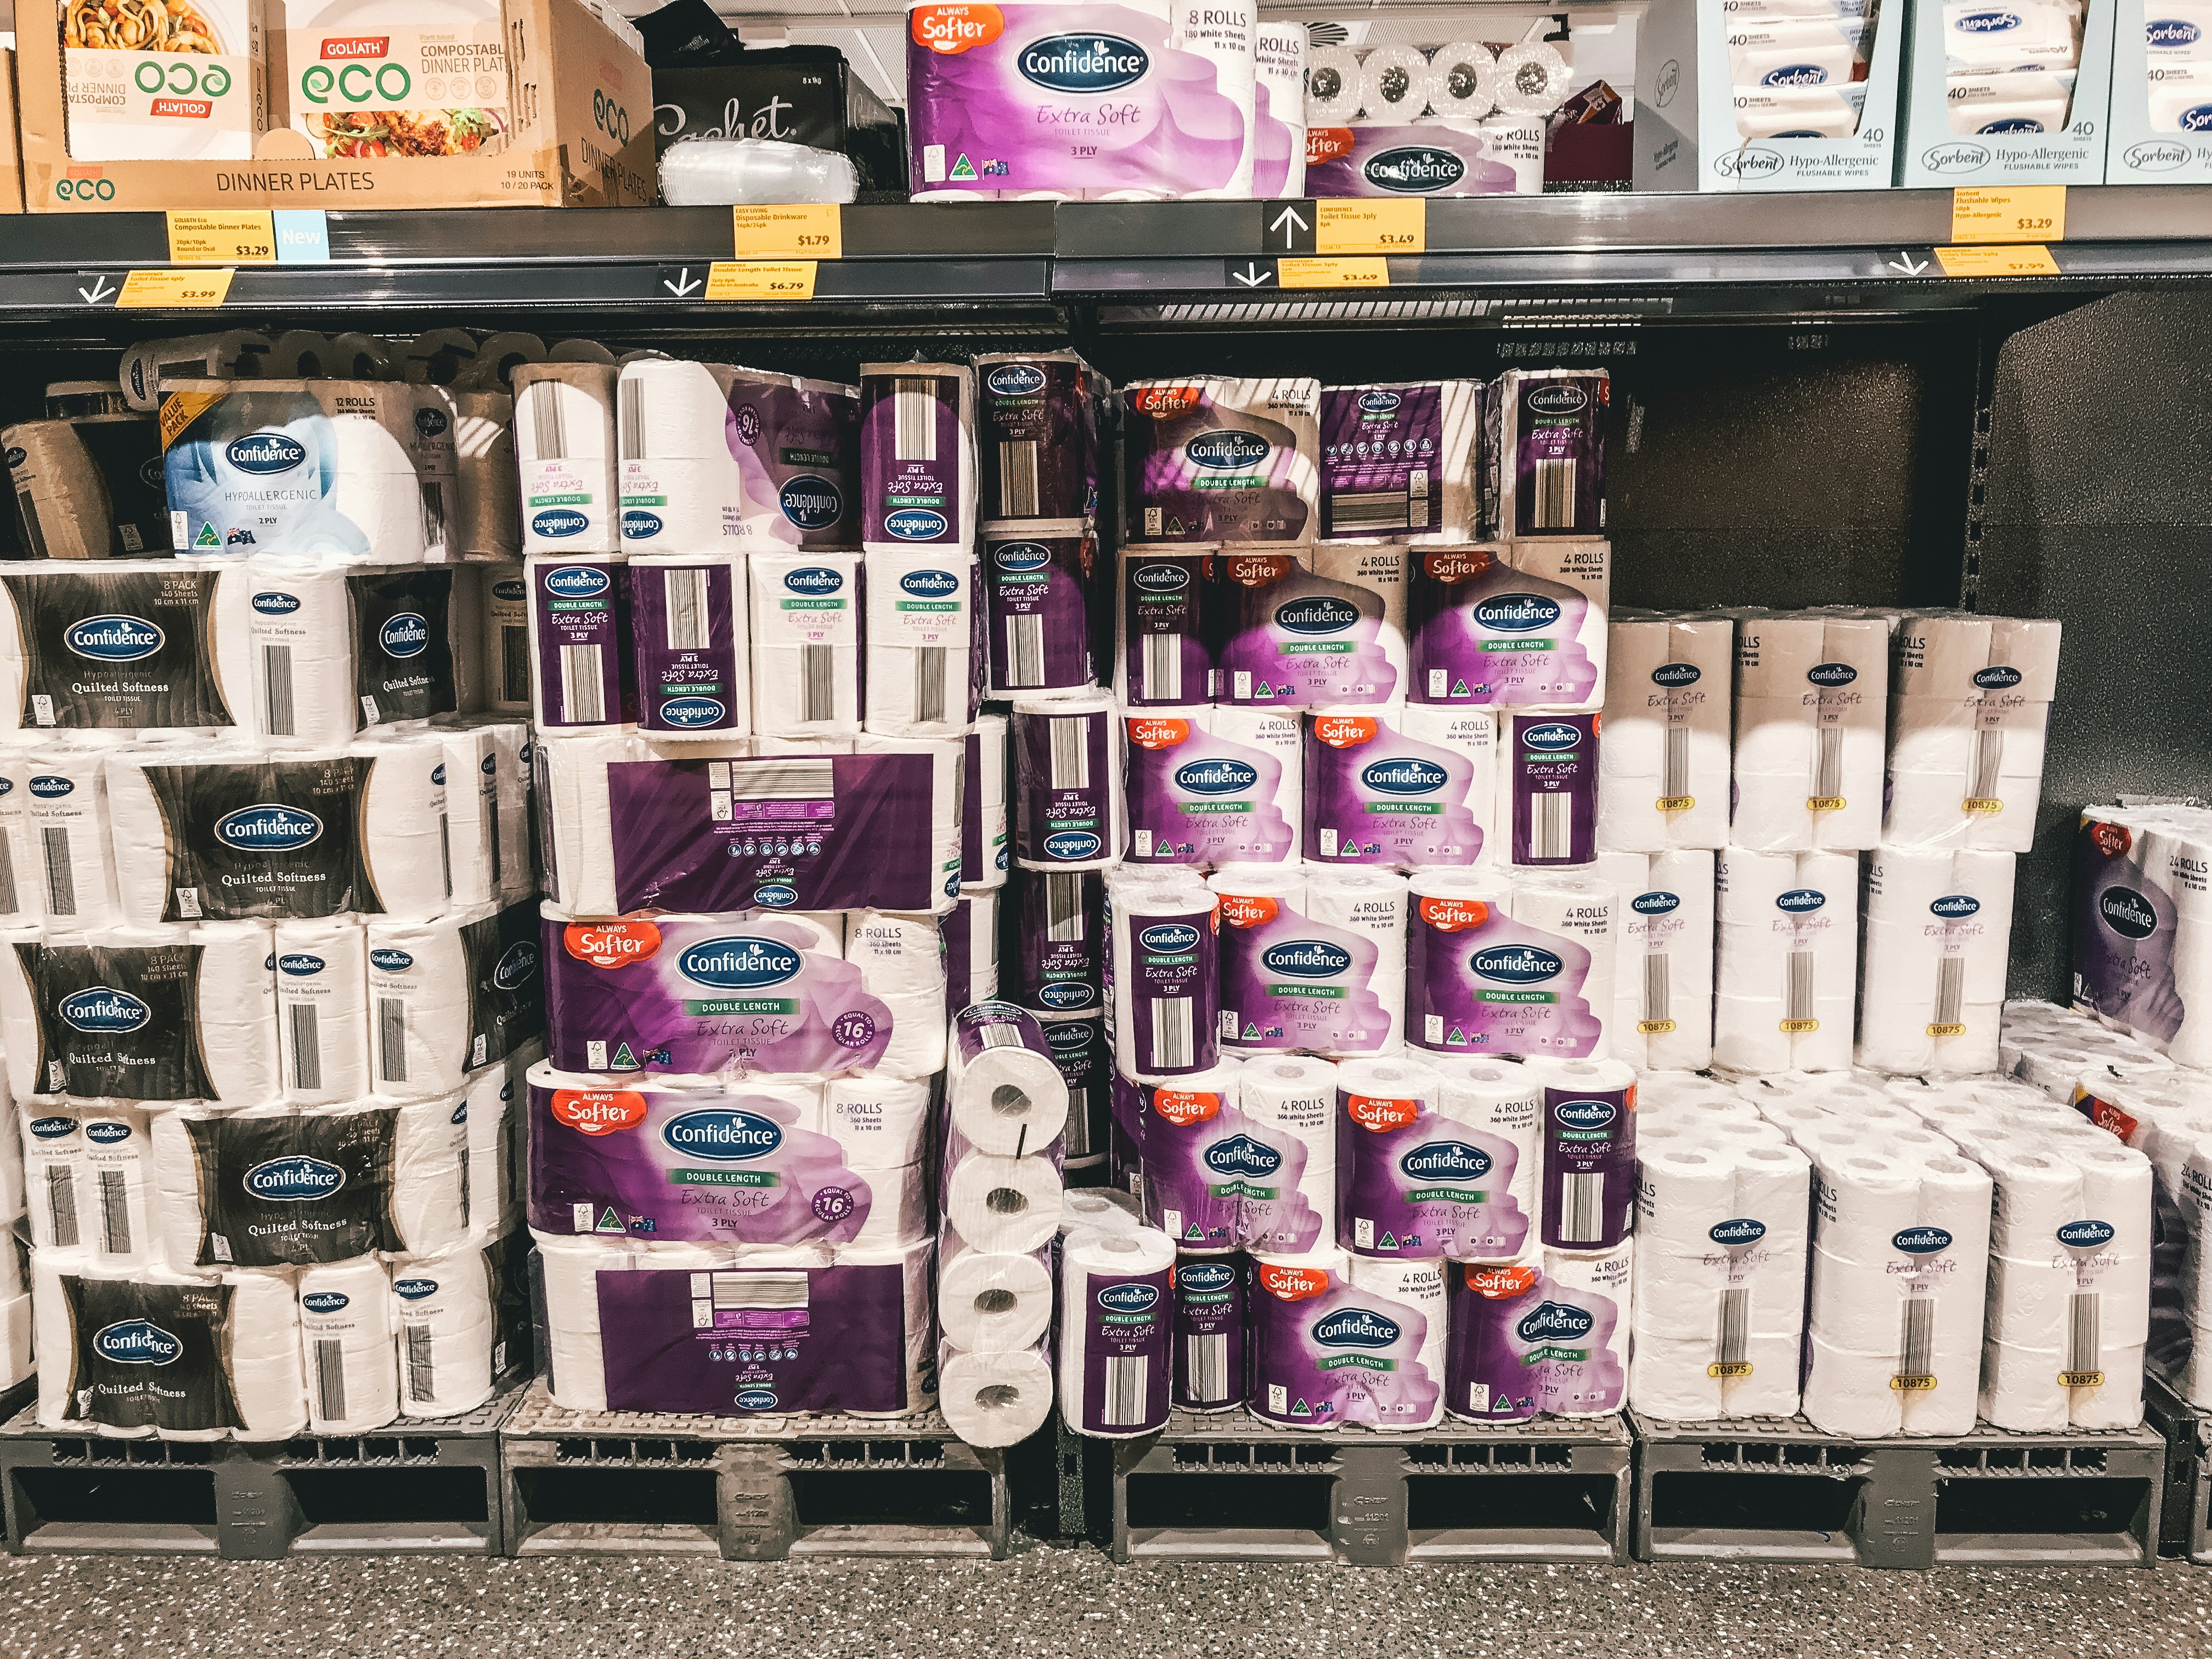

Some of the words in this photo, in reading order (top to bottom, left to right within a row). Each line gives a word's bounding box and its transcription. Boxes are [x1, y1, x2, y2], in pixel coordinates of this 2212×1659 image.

[937, 7, 969, 16] ALWAYS
[1189, 10, 1199, 25] 8
[1204, 10, 1246, 27] ROLLS
[923, 16, 986, 39] Softer
[1960, 14, 2016, 28] Sorbent
[1184, 30, 1198, 38] 180
[1200, 30, 1223, 38] White
[1224, 31, 1245, 40] Sheets
[1728, 34, 1747, 46] 40
[2146, 24, 2195, 44] Sorbent
[421, 59, 470, 74] DINNER
[1026, 52, 1139, 74] Confidence
[302, 63, 411, 103] eco
[1768, 69, 1823, 86] Sorbent
[82, 83, 126, 94] DINNER
[1948, 88, 1967, 99] 40
[1037, 105, 1091, 123] Extra
[1098, 104, 1141, 124] Soft
[1863, 128, 1883, 142] 40
[2072, 121, 2094, 136] 40
[1071, 146, 1077, 156] 3
[1079, 146, 1098, 156] PLY
[2129, 146, 2185, 168] Sorbent
[580, 137, 617, 183] DINNER
[1720, 154, 1779, 176] Sorbent
[1790, 155, 1879, 167] Hypo-Allergenic
[1928, 149, 1985, 171] Sorbent
[1996, 148, 2089, 162] Hypo-Allergenic
[217, 172, 294, 192] DINNER
[300, 171, 374, 191] PLATES
[507, 171, 517, 179] 19
[519, 171, 545, 179] UNITS
[56, 178, 115, 201] eco
[501, 182, 509, 190] 10
[518, 182, 528, 190] 20
[530, 182, 555, 190] PACK
[2017, 218, 2053, 230] $3.29
[282, 229, 321, 245] New
[798, 235, 830, 246] $1.79
[1380, 234, 1414, 244] $3.49
[236, 245, 269, 255] $3.29
[770, 282, 804, 290] $6.79
[180, 290, 216, 298] $3.99
[1272, 390, 1279, 400] 4
[1282, 389, 1310, 400] ROLLS
[335, 398, 344, 407] 12
[346, 397, 375, 407] ROLLS
[231, 446, 298, 463] Confidence
[1191, 442, 1264, 457] Confidence
[225, 490, 317, 502] HYPOALLERGENIC
[889, 518, 942, 532] Confidence
[164, 582, 170, 590] 8
[172, 580, 197, 590] PACK
[550, 577, 603, 586] Confidence
[904, 577, 956, 589] Confidence
[1480, 605, 1555, 620] Confidence
[74, 629, 154, 646] Confidence
[385, 621, 426, 644] Confidence
[72, 683, 118, 693] Quilted
[122, 682, 169, 692] Softness
[1528, 732, 1577, 742] Confidence
[1662, 799, 1689, 808] 10875
[1813, 799, 1840, 808] 10875
[1967, 801, 1997, 810] 10875
[225, 821, 311, 838] Confidence
[2170, 856, 2179, 868] 24
[2180, 857, 2208, 873] ROLLS
[222, 873, 273, 887] Quilted
[277, 871, 326, 882] Softness
[1566, 909, 1573, 918] 4
[1577, 907, 1608, 918] ROLLS
[2103, 898, 2152, 928] Confidence
[855, 928, 862, 939] 8
[866, 928, 901, 938] ROLLS
[687, 951, 791, 972] Confidence
[67, 1000, 140, 1019] Confidence
[702, 1003, 740, 1012] DOUBLE
[743, 1002, 780, 1011] LENGTH
[843, 1021, 864, 1038] 16
[1643, 1022, 1671, 1031] 10875
[582, 1093, 613, 1102] ALWAYS
[567, 1100, 631, 1123] Softer
[254, 1170, 335, 1188] Confidence
[681, 1189, 727, 1206] Extra
[734, 1190, 770, 1208] Soft
[249, 1221, 296, 1235] Quilted
[302, 1217, 347, 1231] Softness
[1897, 1233, 1947, 1247] Confidence
[1104, 1289, 1154, 1303] Confidence
[1318, 1318, 1393, 1339] Confidence
[1714, 1364, 1747, 1376] 10875
